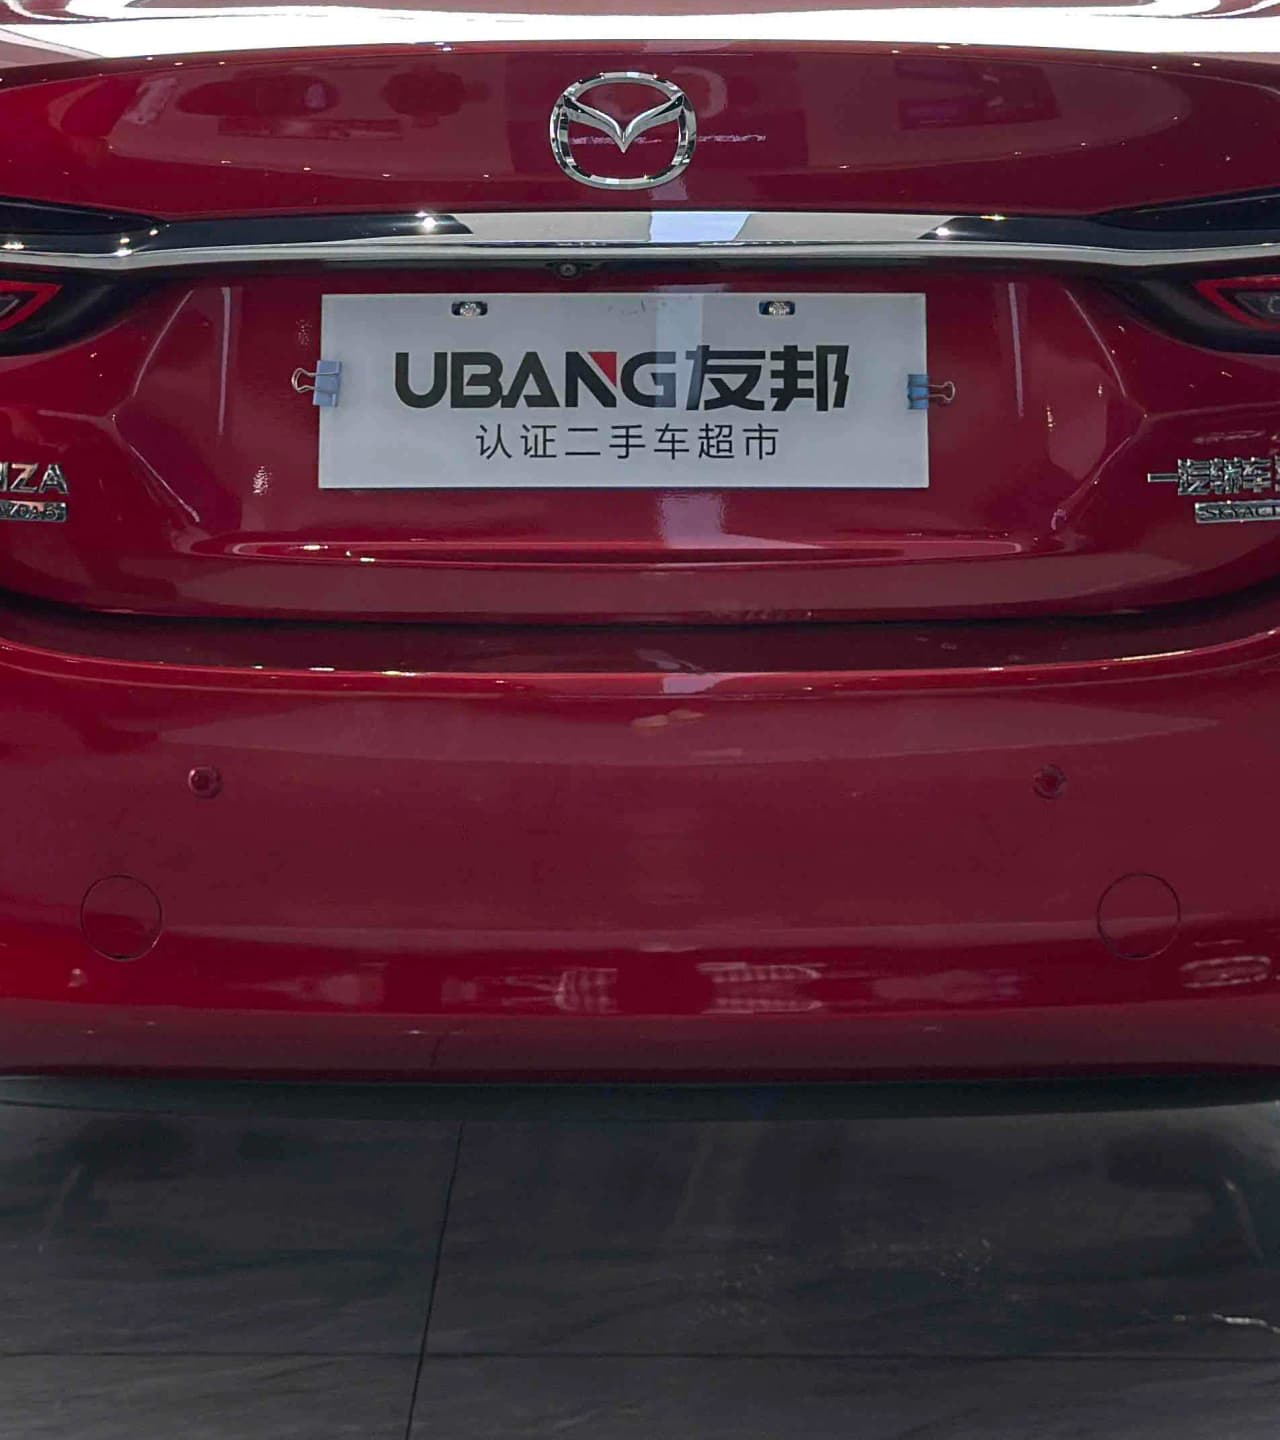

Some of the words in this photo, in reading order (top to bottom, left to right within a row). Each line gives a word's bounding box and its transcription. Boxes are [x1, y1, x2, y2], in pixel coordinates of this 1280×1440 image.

[475, 422, 780, 460] 认证二手车超市
